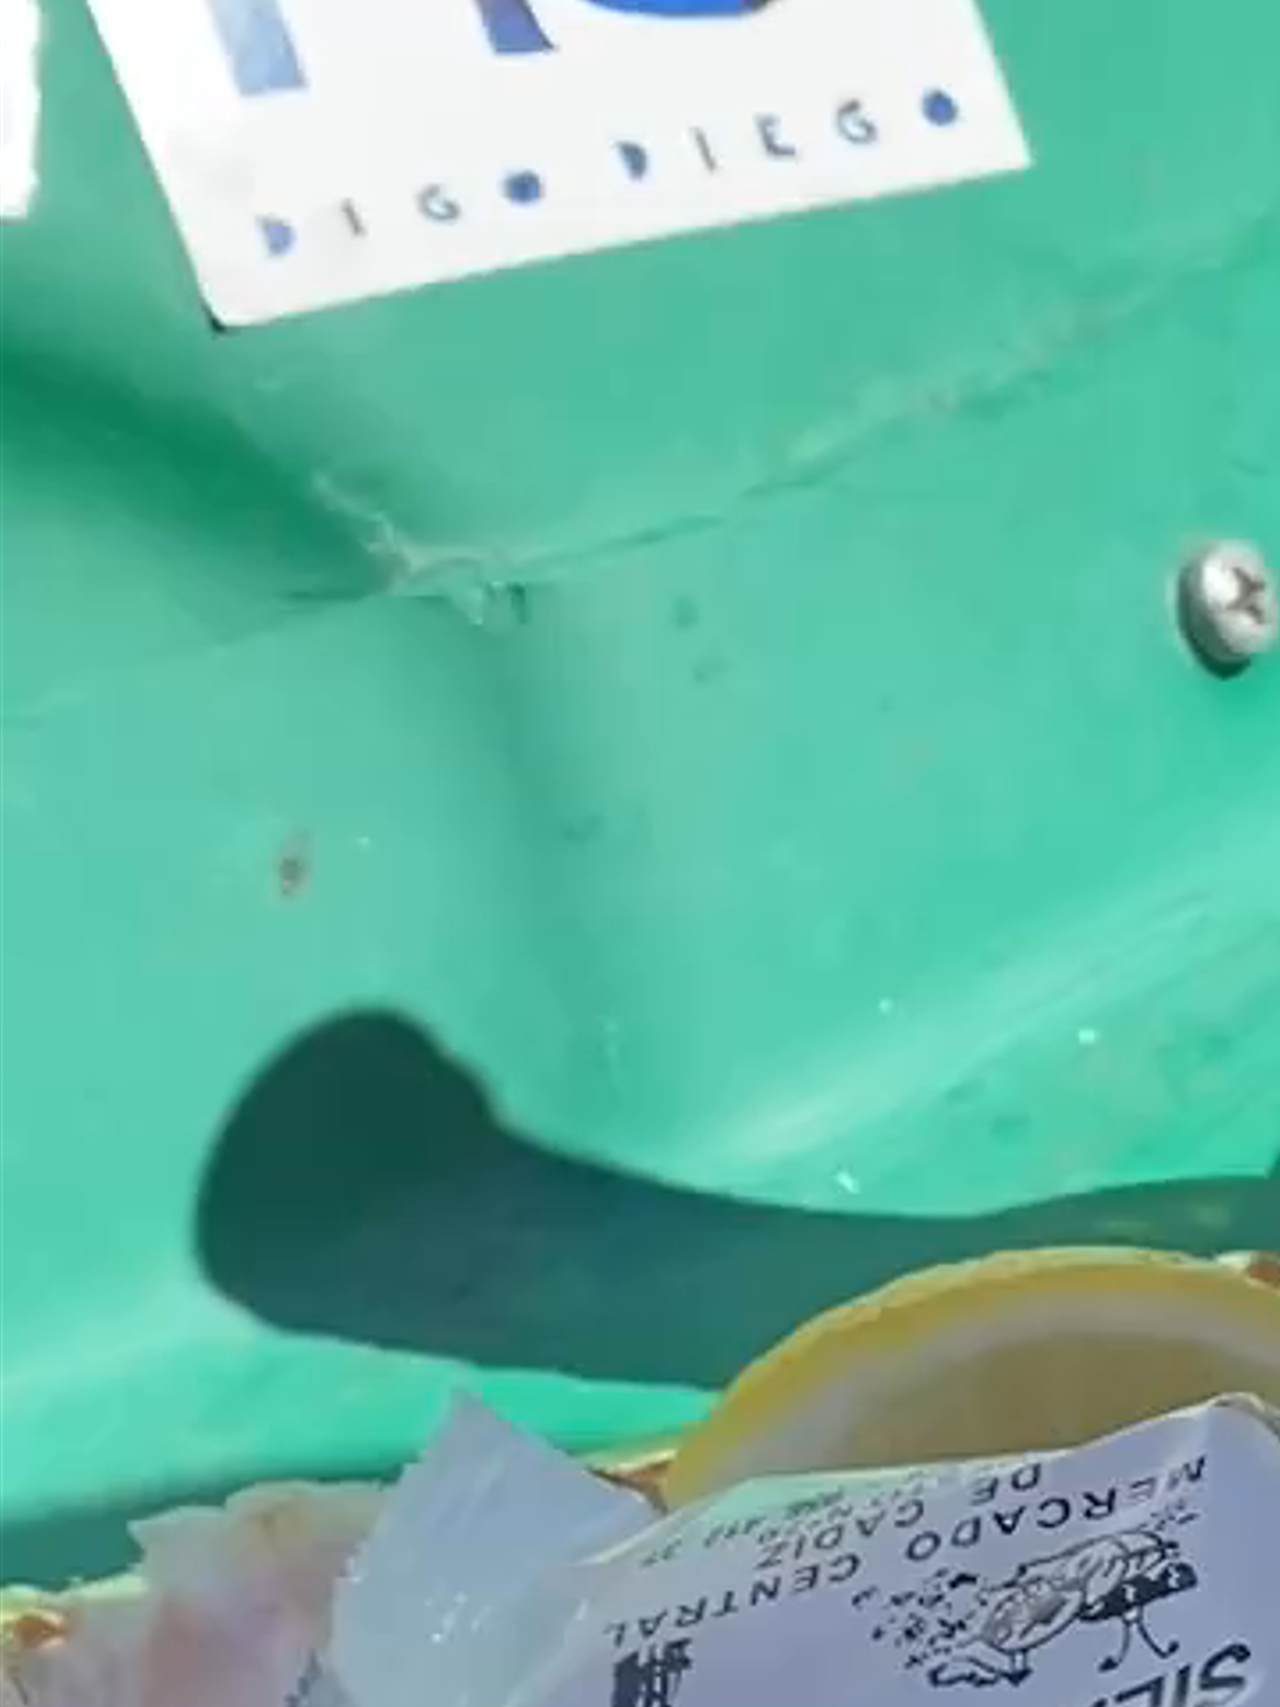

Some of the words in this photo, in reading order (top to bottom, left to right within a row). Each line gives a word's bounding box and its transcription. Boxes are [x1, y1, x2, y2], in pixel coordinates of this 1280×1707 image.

[754, 1497, 925, 1570] CADIZ
[905, 1454, 1207, 1564] MERCADO
[601, 1553, 861, 1648] CENTRAL
